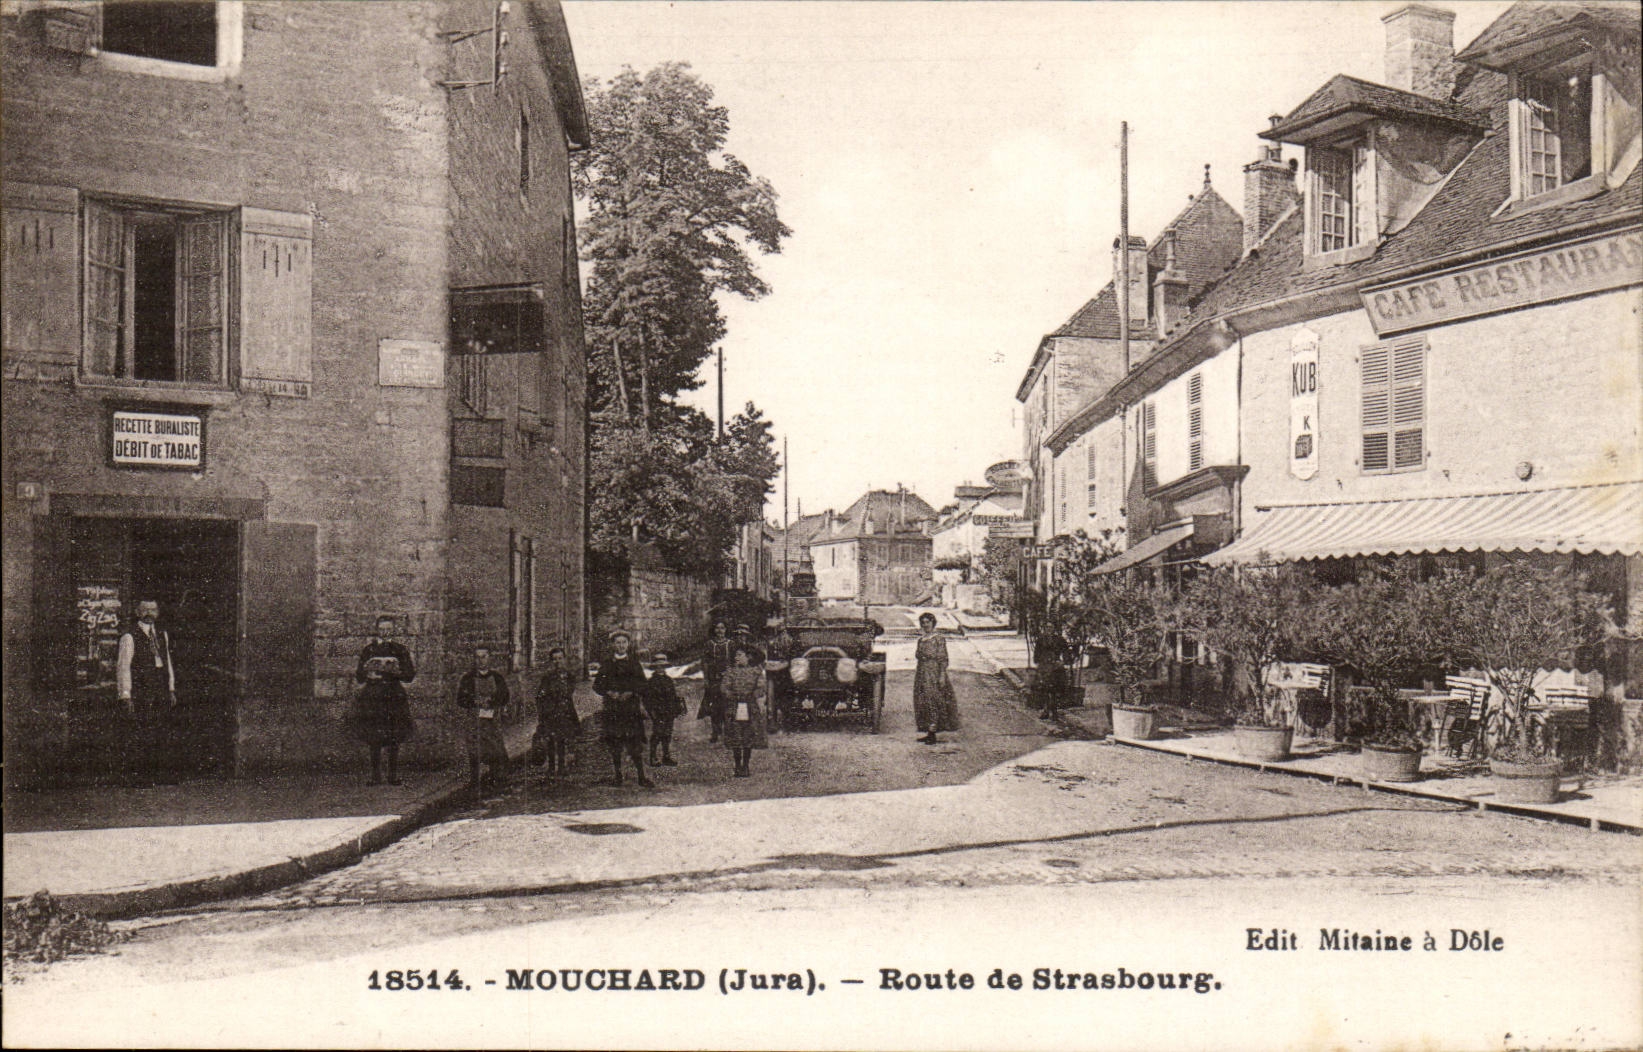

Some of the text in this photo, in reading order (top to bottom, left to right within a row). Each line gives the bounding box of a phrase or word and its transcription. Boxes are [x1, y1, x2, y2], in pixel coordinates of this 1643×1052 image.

[1292, 362, 1316, 397] KUB
[114, 418, 200, 437] RECETTE BURALISTE
[115, 438, 149, 458] DÉBIT
[164, 442, 198, 460] TABAC
